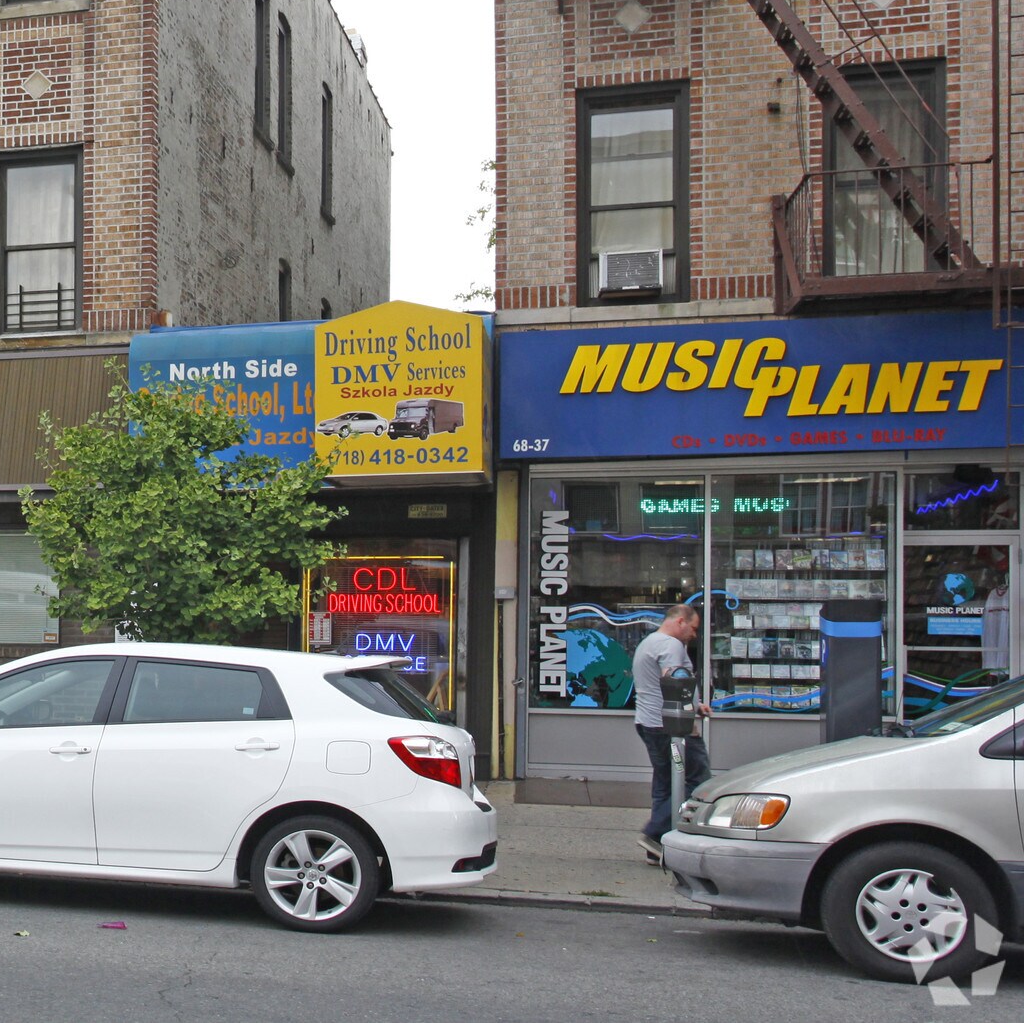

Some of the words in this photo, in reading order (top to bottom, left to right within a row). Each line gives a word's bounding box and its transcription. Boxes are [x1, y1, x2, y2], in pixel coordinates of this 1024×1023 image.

[324, 328, 397, 362] Driving
[405, 323, 471, 352] School
[169, 361, 236, 381] North
[245, 359, 298, 378] Side
[331, 363, 401, 385] DMV
[407, 360, 466, 381] Services
[559, 337, 786, 394] MUSIC
[743, 359, 1004, 417] PLANET
[213, 382, 285, 422] School,
[293, 380, 315, 415] Lt
[340, 385, 397, 399] Szkola
[403, 383, 454, 397] Jazdy
[513, 439, 550, 452] 68-37
[671, 435, 701, 448] CDs
[724, 434, 767, 447] DVDs
[789, 431, 848, 445] GAMES
[872, 428, 946, 444] BLU-RAY
[328, 449, 365, 466] (718)
[369, 446, 469, 465] 418-0342
[640, 498, 720, 513] GAMES
[734, 497, 790, 512] MUS
[539, 510, 569, 596] MUSIC
[353, 567, 417, 591] CDL
[328, 594, 382, 613] DRIVING
[386, 594, 441, 613] SCHOOL
[926, 606, 954, 614] MUSIC
[955, 607, 985, 615] PLANET
[355, 633, 415, 651] DMV
[539, 606, 568, 698] PLANET
